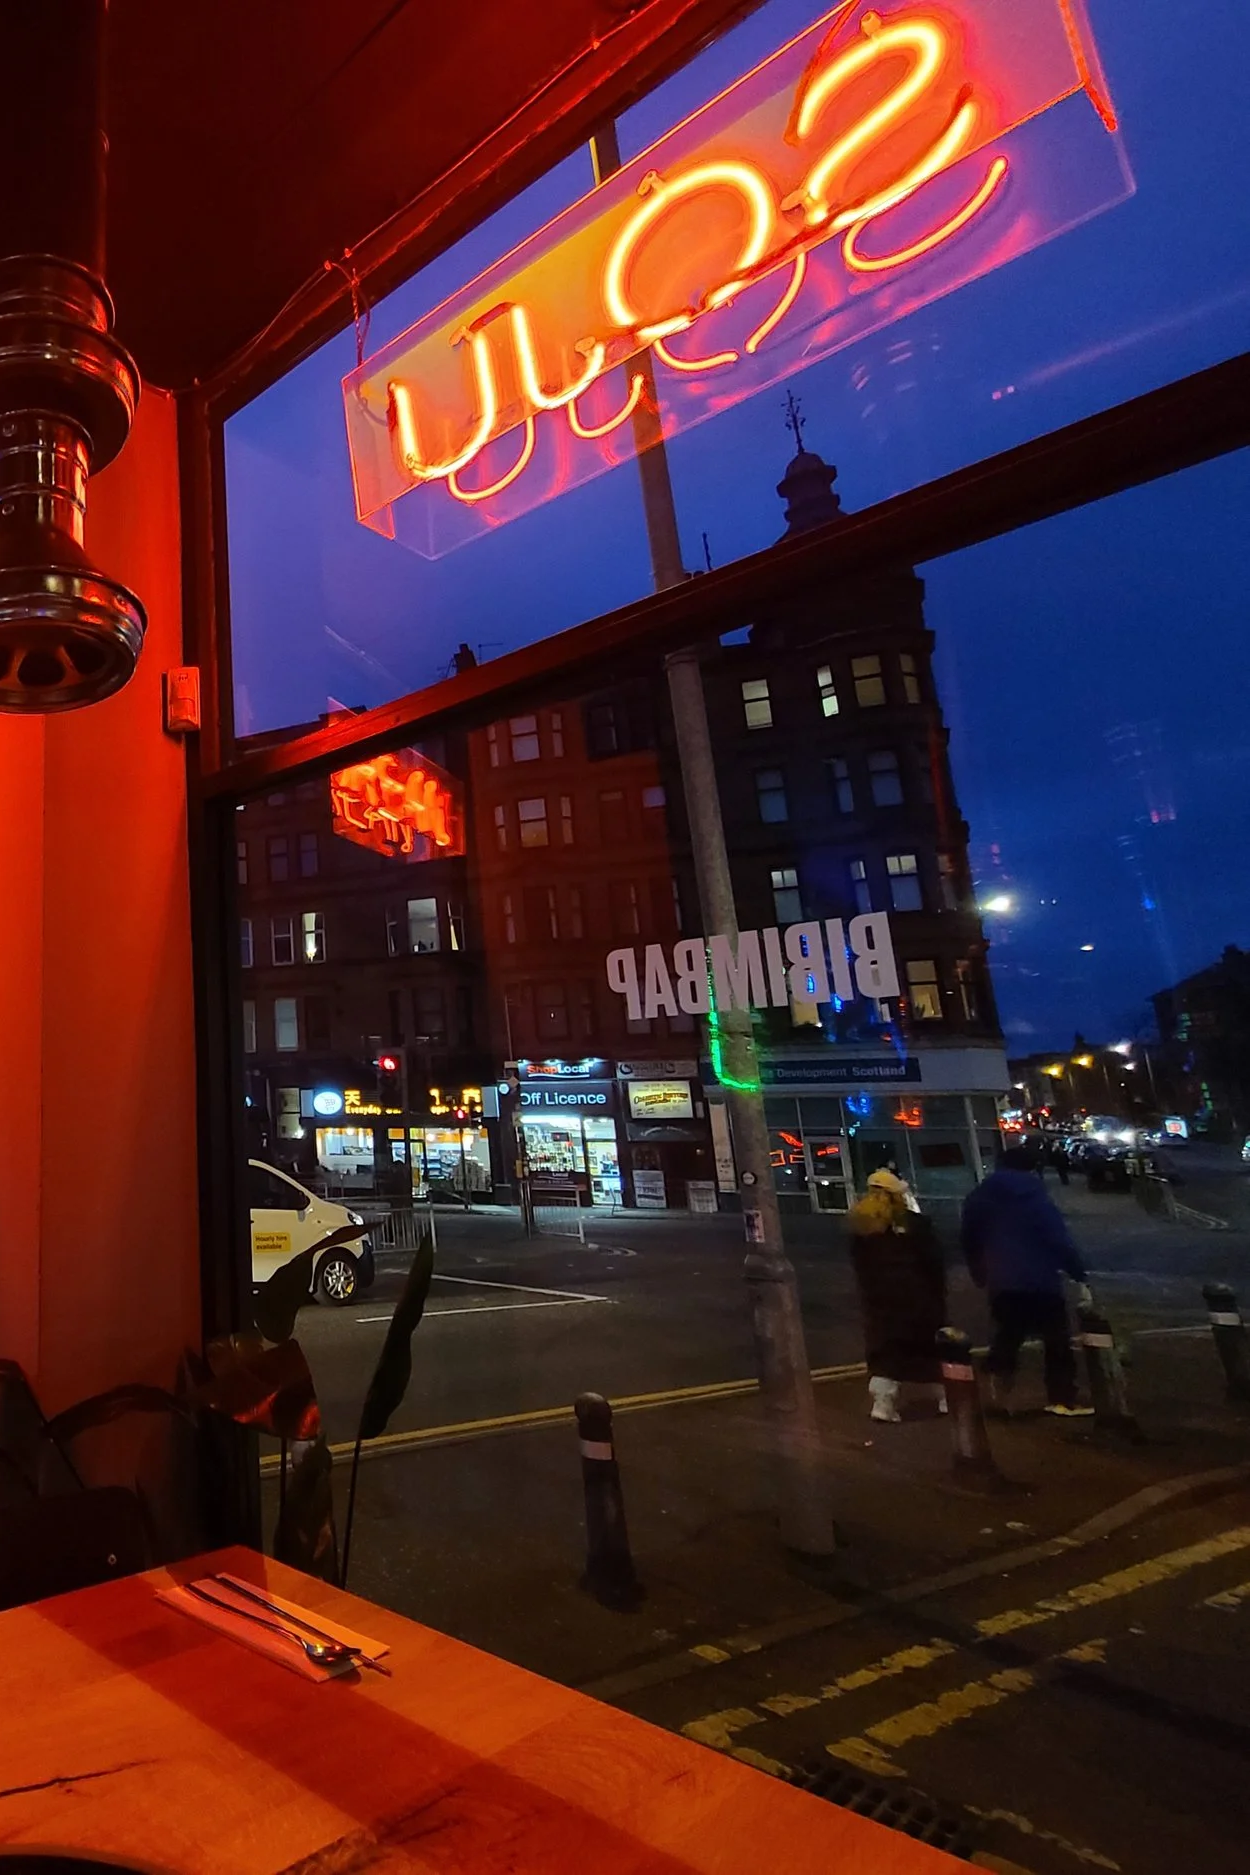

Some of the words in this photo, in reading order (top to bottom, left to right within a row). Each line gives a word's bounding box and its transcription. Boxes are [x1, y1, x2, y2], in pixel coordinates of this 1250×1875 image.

[777, 1069, 847, 1079] Development
[852, 1066, 905, 1077] Scotland
[545, 1091, 606, 1105] Licence
